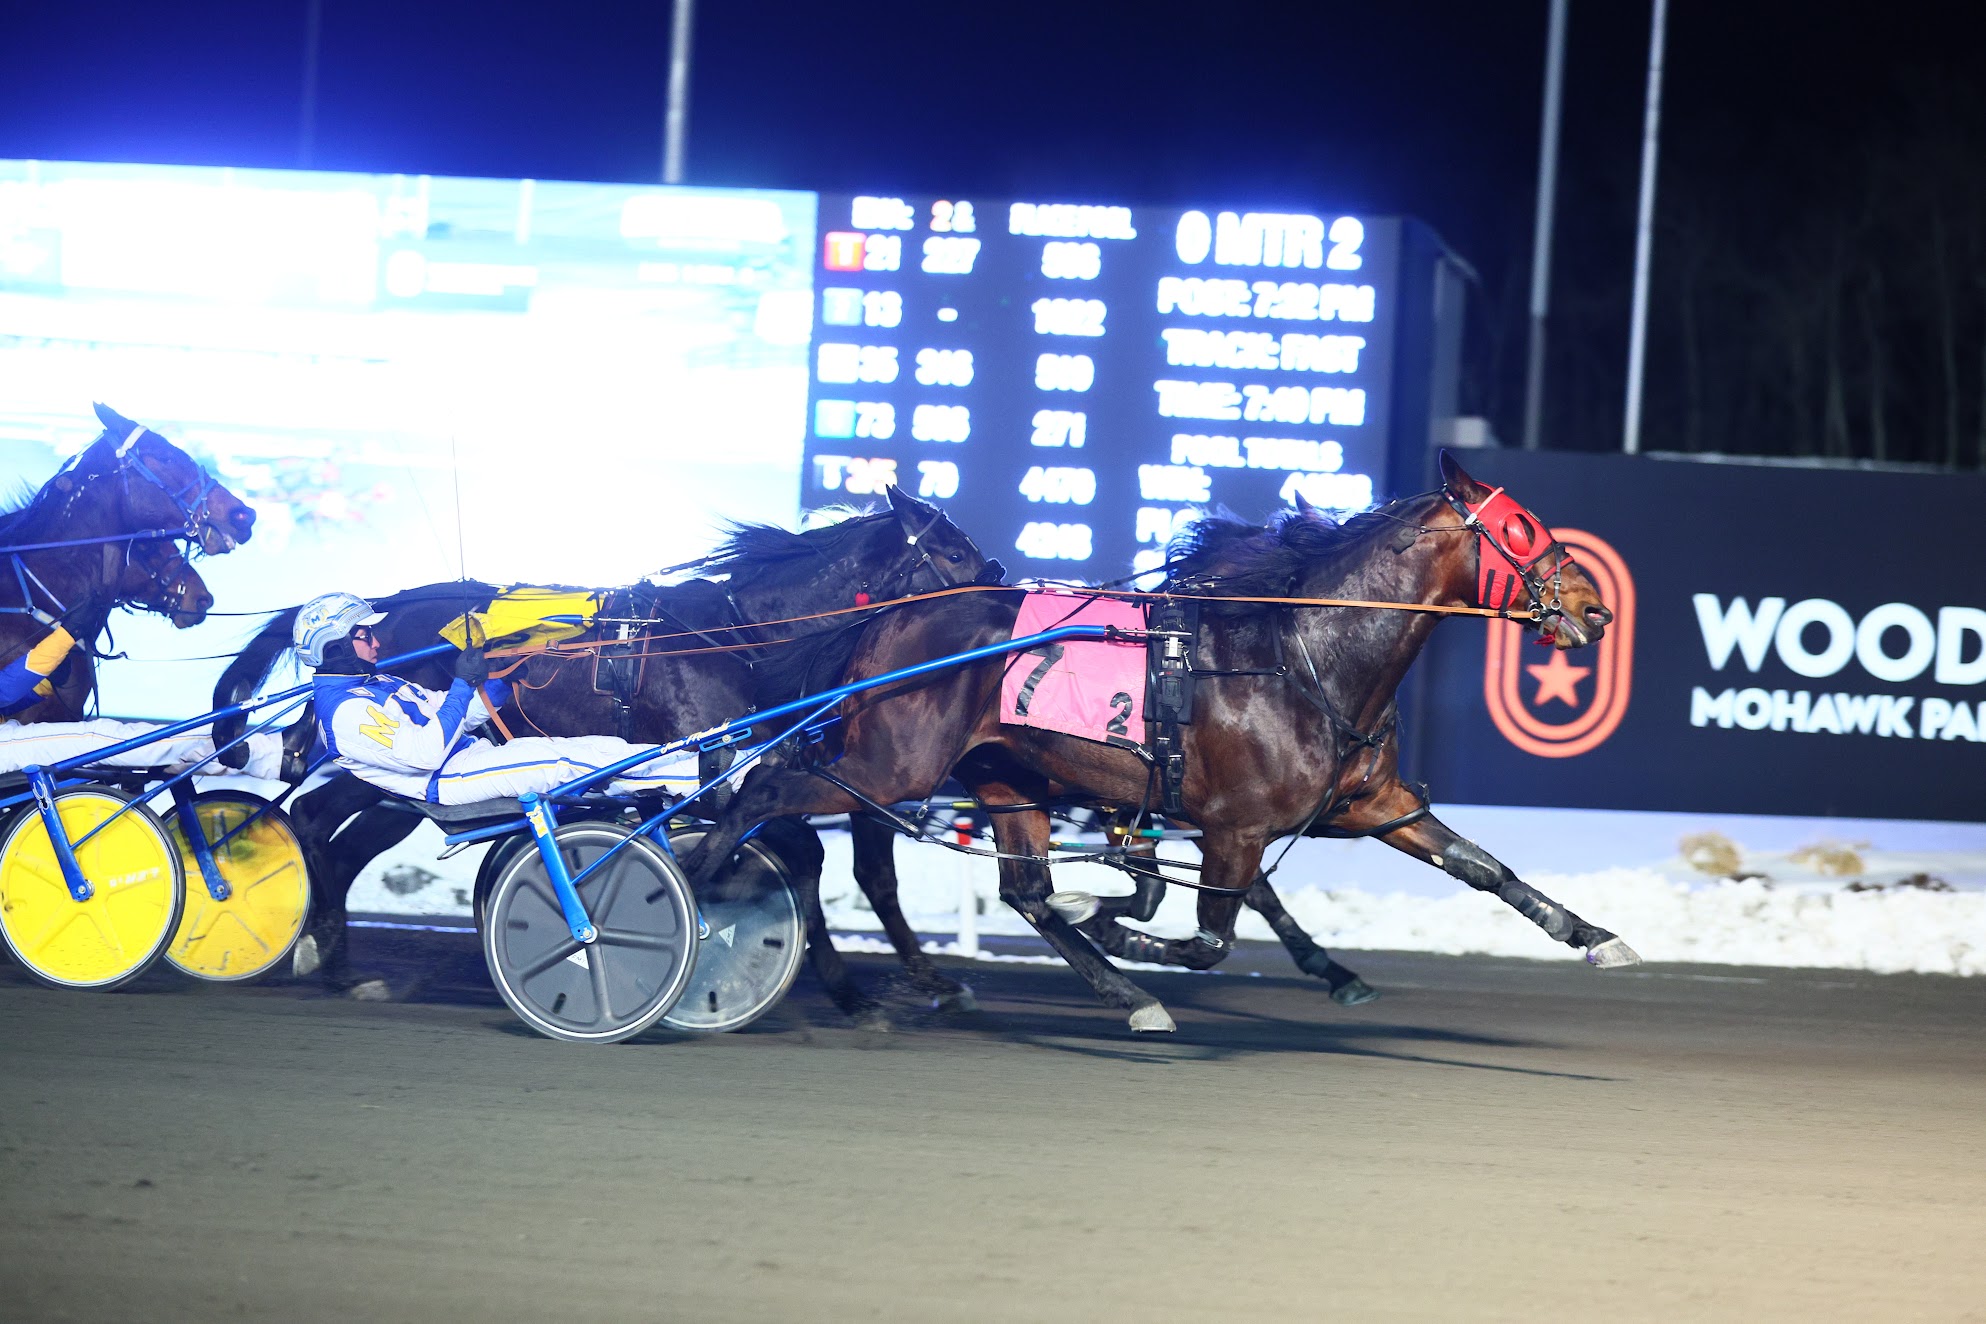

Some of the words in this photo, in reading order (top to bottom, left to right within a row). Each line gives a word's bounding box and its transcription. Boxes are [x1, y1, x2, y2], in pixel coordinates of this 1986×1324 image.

[1326, 216, 1364, 270] 2
[1015, 641, 1065, 717] 7
[1106, 691, 1133, 736] 2
[1690, 686, 1914, 738] MOHAWK
[1920, 697, 1986, 743] PA
